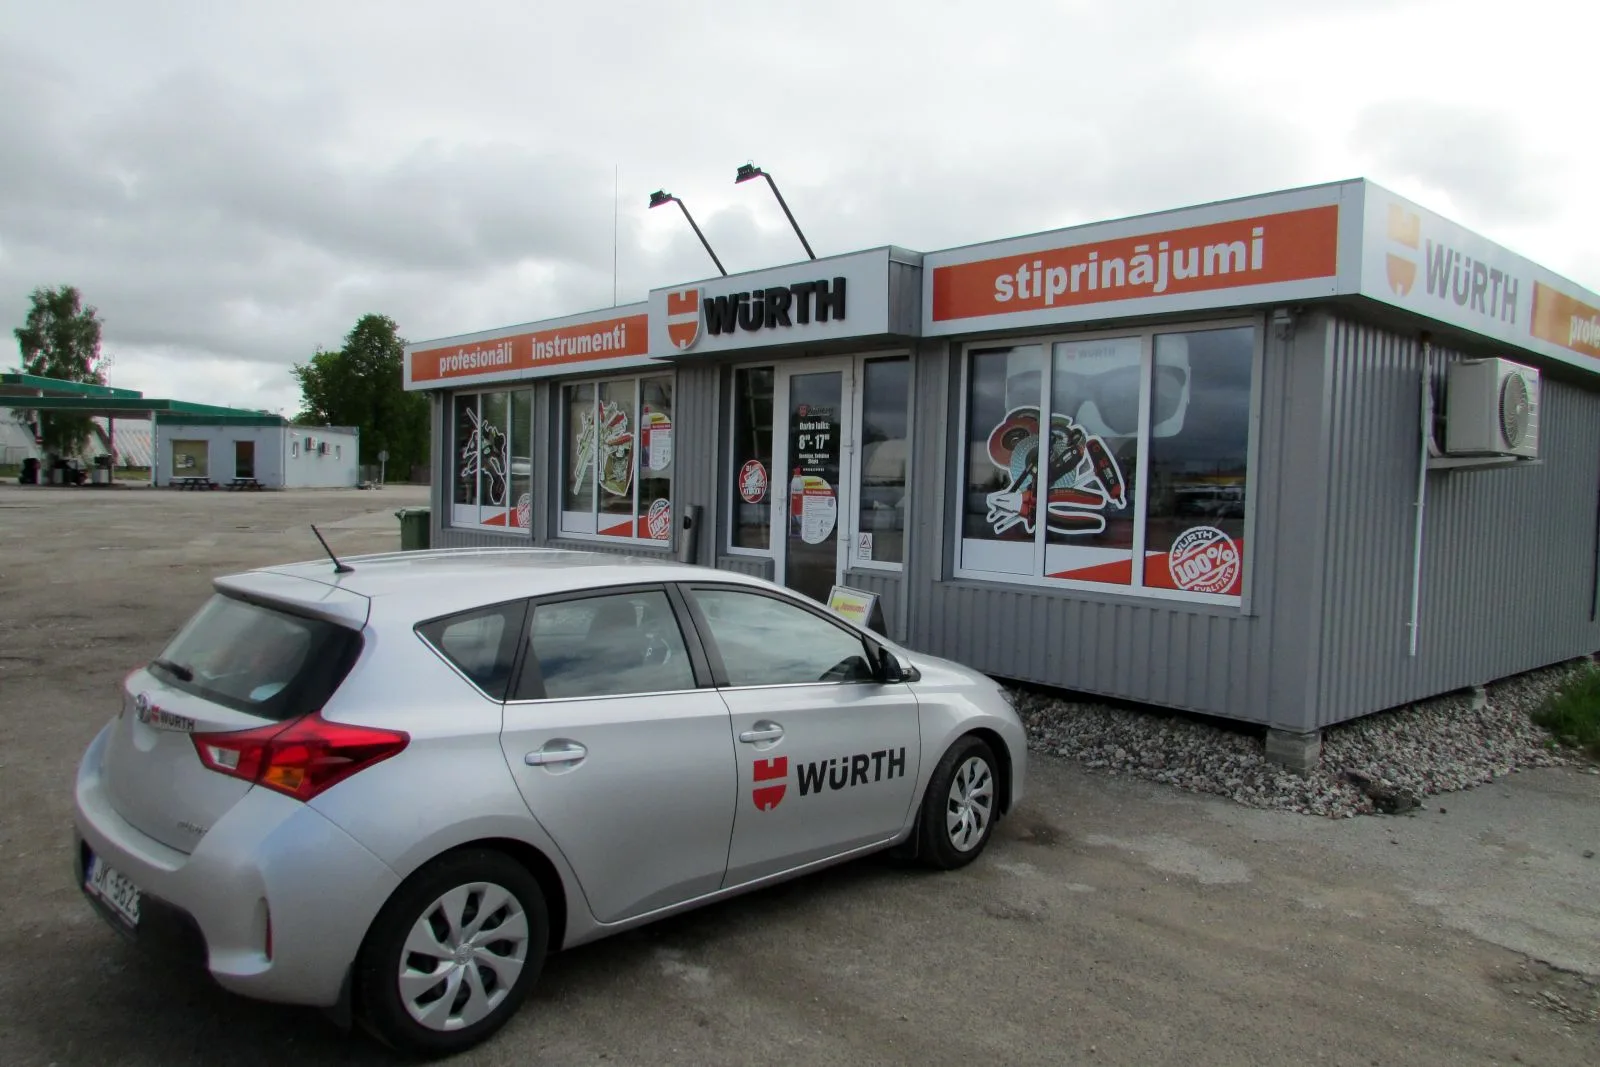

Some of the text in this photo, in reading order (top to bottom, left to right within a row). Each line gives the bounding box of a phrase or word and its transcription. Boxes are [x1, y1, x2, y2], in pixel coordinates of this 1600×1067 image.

[993, 227, 1264, 305] stiprinājumi
[1425, 238, 1519, 325] WÜRTH
[703, 276, 847, 336] WÜRTH
[439, 323, 626, 377] profesionāli instrumenti
[1174, 543, 1234, 585] 100%
[796, 747, 906, 797] WÜRTH
